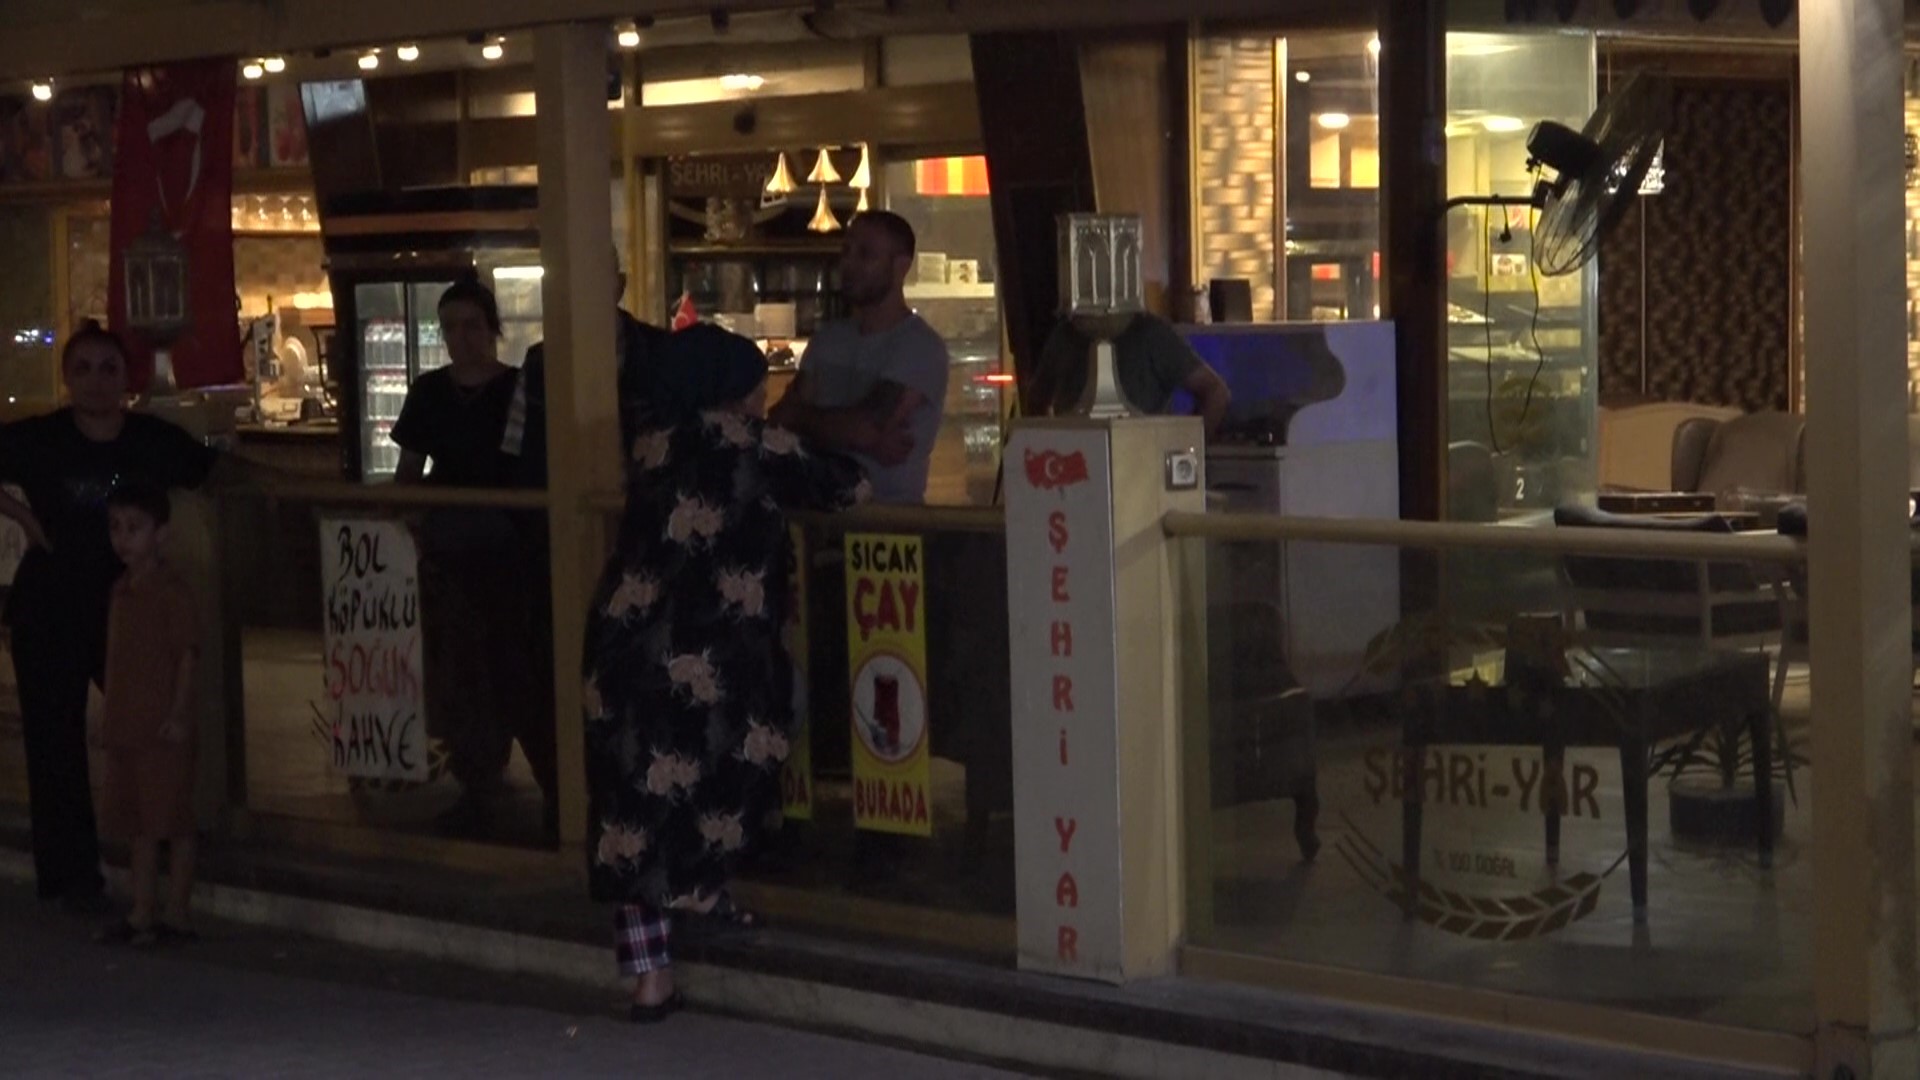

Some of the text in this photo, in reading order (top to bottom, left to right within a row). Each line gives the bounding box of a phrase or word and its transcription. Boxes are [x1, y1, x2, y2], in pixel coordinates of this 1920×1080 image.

[337, 526, 387, 581] BOL
[852, 541, 917, 573] SICAK
[854, 577, 919, 642] ÇAY
[332, 704, 416, 770] KAHVE
[856, 778, 928, 824] BURADA
[1055, 817, 1078, 962] YAR
